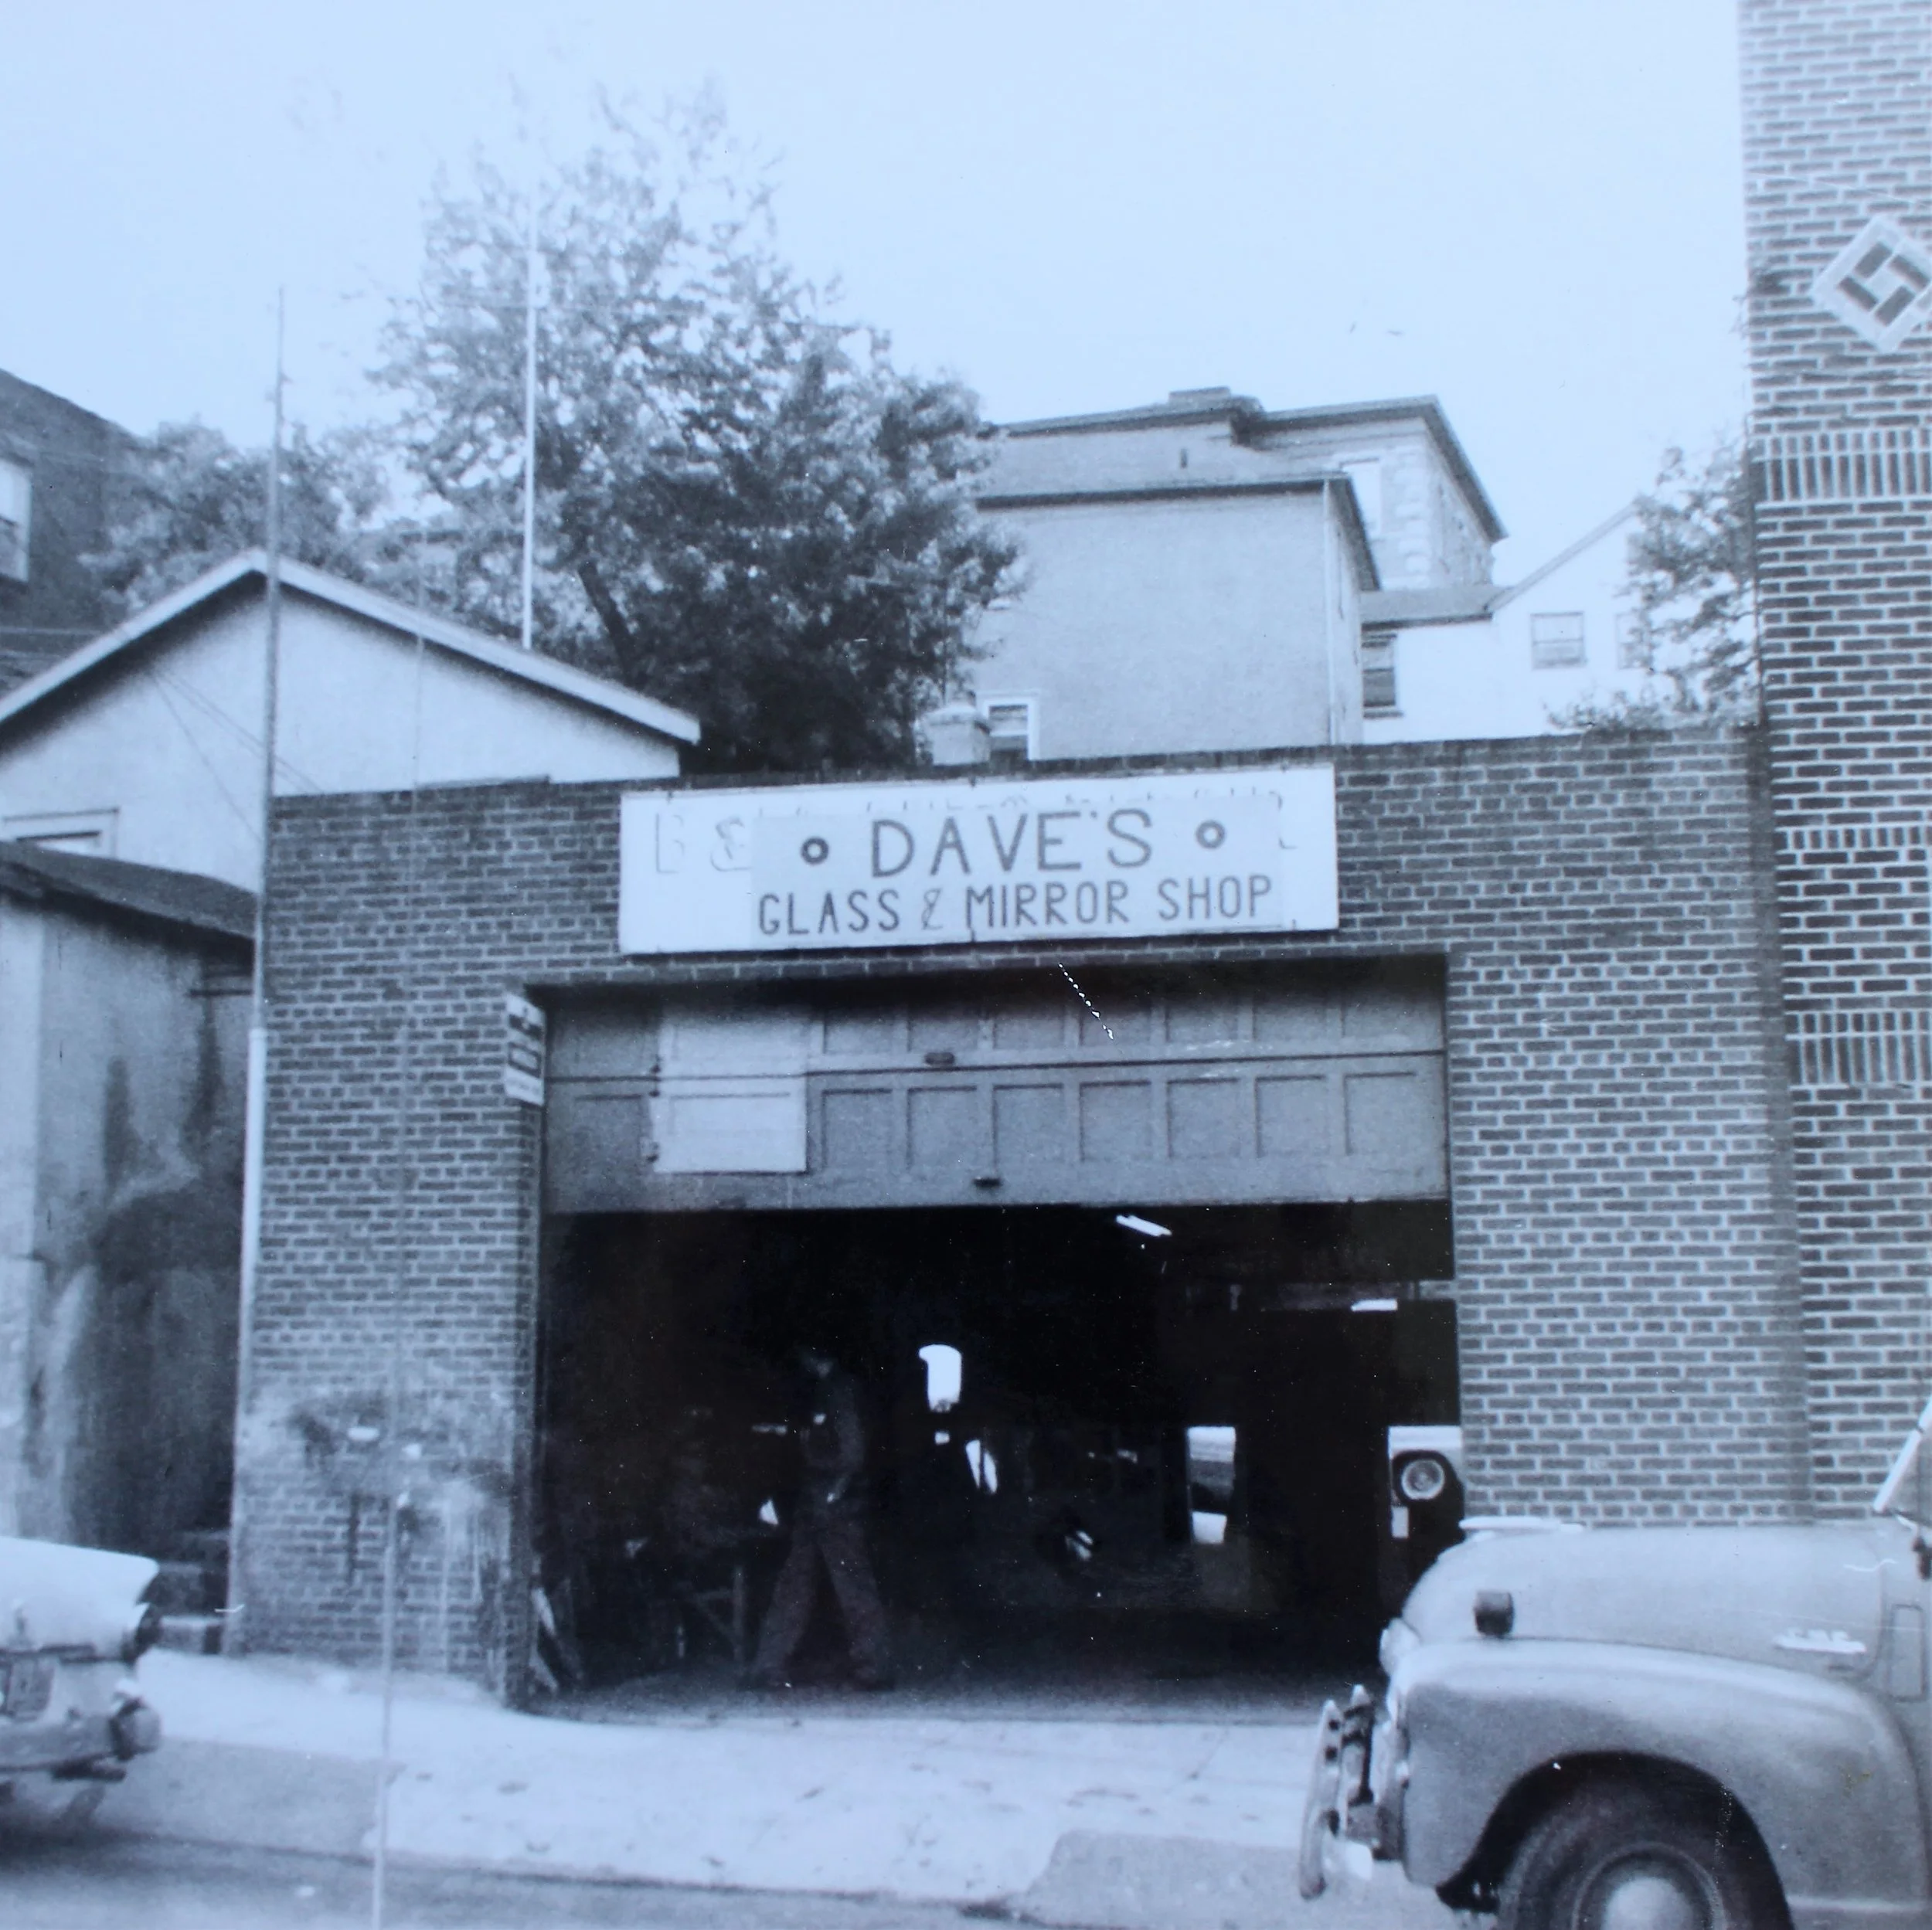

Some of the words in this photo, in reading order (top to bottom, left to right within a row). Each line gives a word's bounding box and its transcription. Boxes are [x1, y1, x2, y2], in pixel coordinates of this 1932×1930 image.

[872, 807, 1153, 878] DAVE'S
[758, 888, 900, 936] GLASS
[922, 887, 944, 930] &
[966, 879, 1130, 927] MIRROR
[1158, 874, 1272, 921] SHOP
